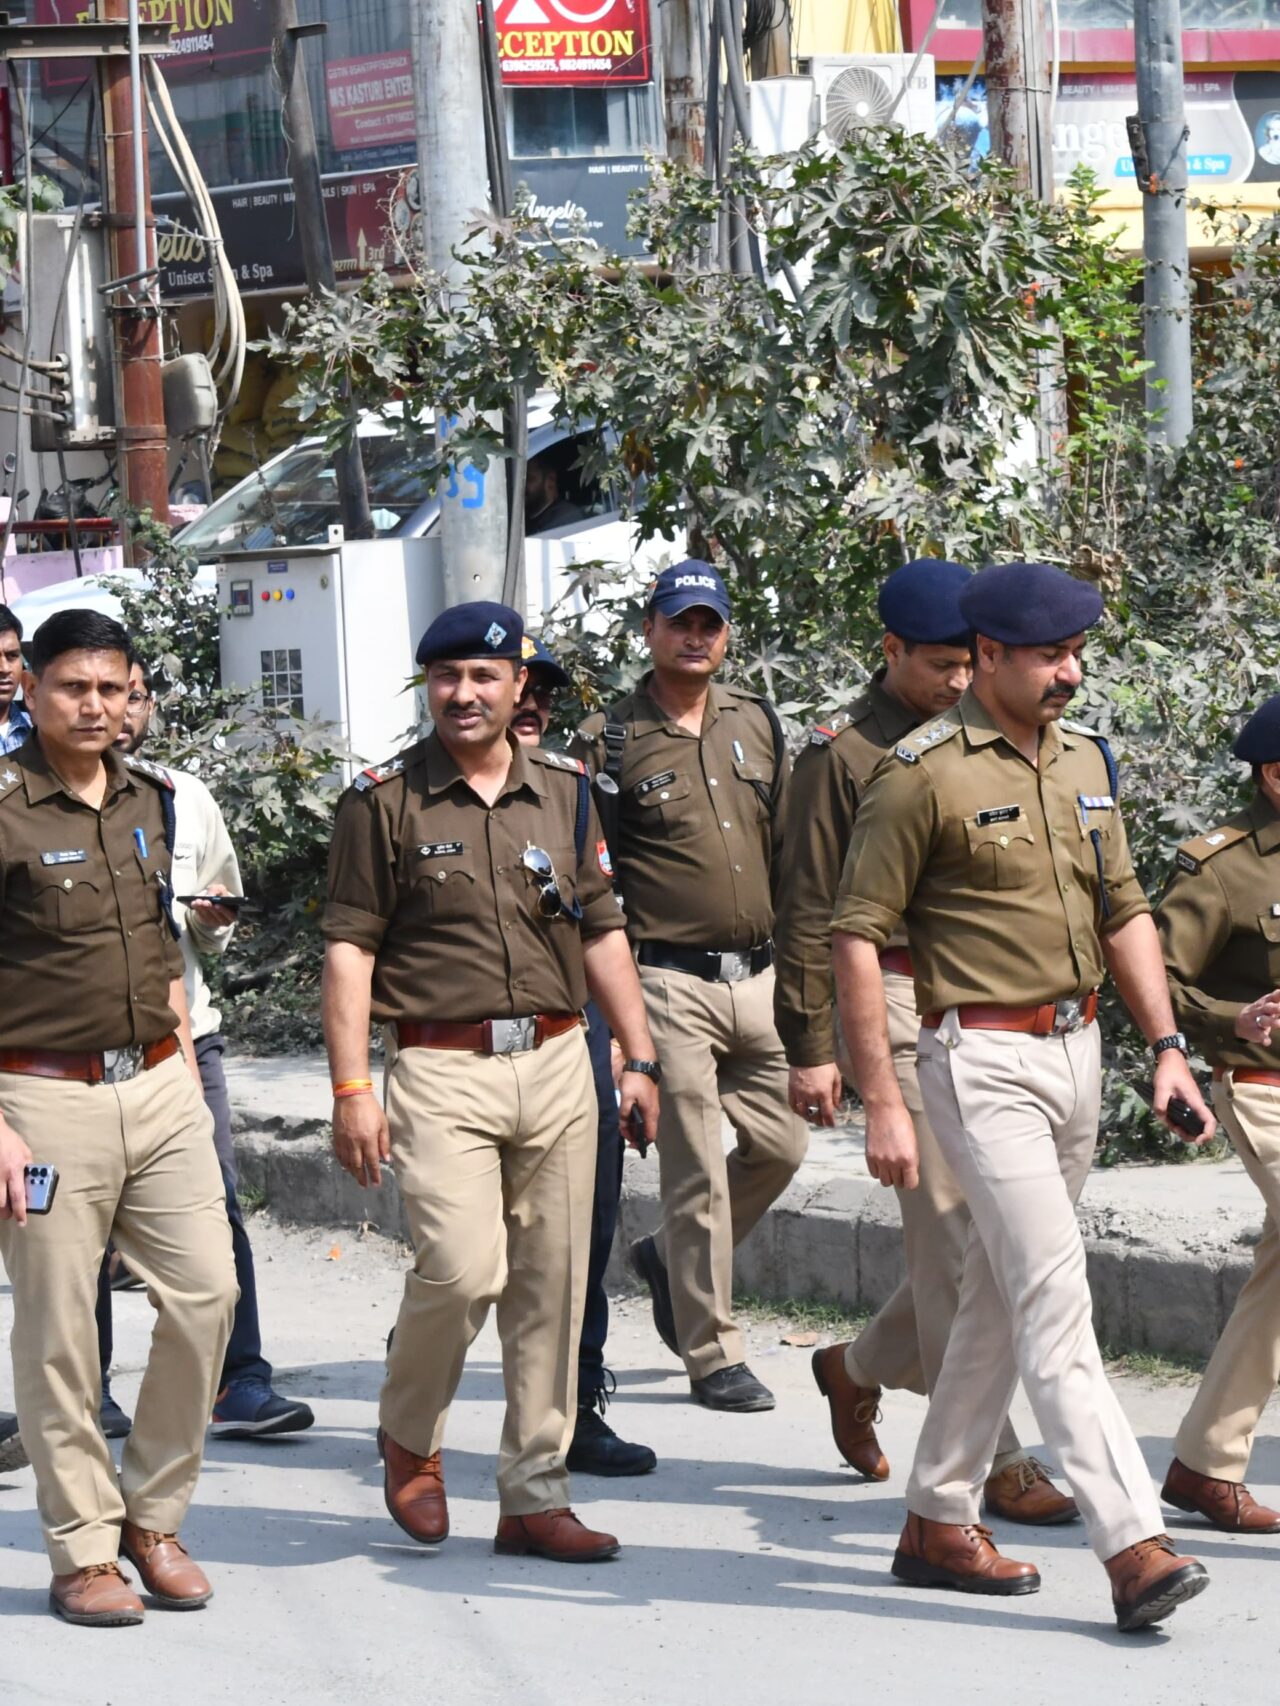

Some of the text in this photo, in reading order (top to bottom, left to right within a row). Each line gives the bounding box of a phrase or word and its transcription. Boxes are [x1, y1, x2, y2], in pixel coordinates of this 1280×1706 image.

[497, 30, 634, 57] CEPTION
[1062, 85, 1094, 94] BEAUTY
[1204, 83, 1220, 92] SPA
[232, 198, 248, 208] HAIR
[253, 195, 278, 207] BEAUTY
[362, 182, 376, 193] SPA
[368, 247, 385, 261] 3rd
[168, 270, 206, 287] Unisex
[241, 267, 251, 280] &
[252, 264, 274, 283] Spa
[675, 575, 717, 591] POLICE
